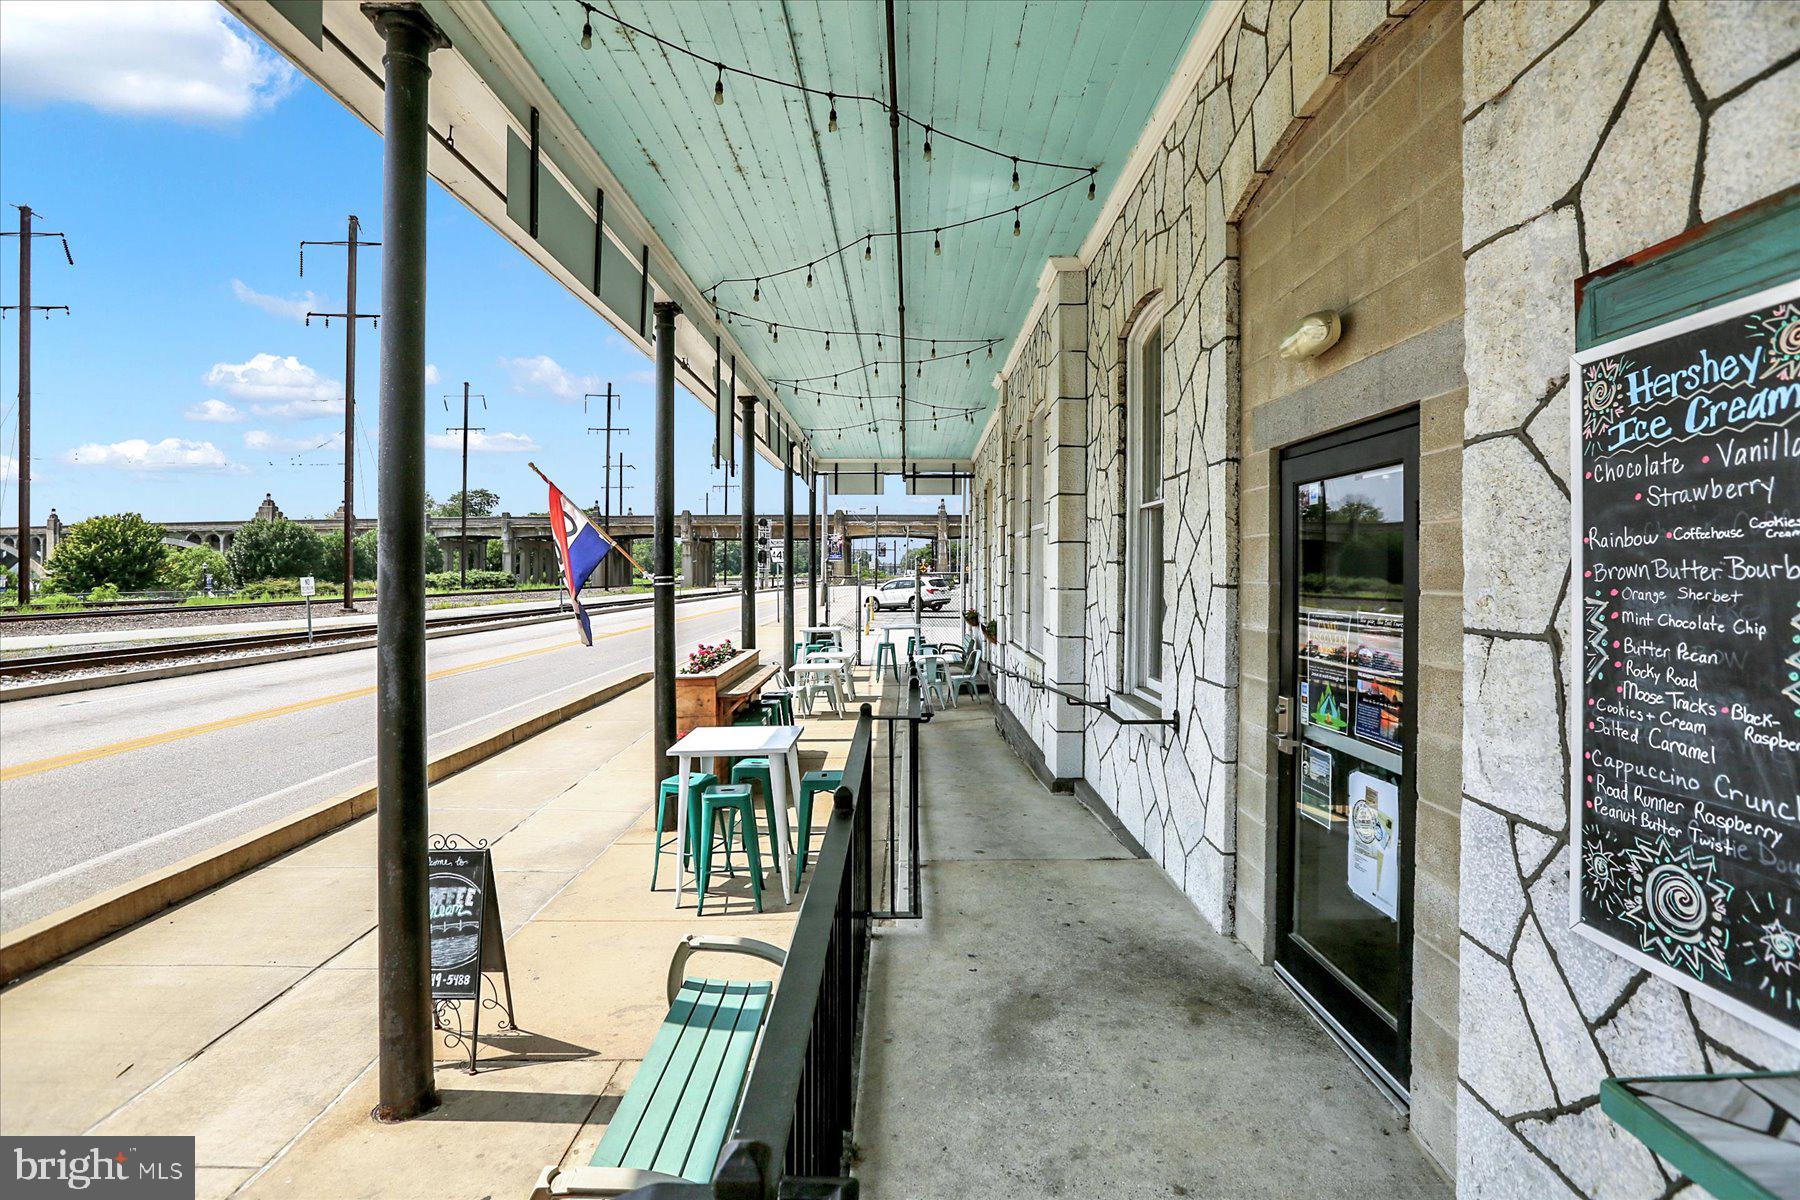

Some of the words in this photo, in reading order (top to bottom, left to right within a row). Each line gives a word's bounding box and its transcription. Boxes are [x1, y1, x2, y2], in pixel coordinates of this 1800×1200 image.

[1625, 346, 1762, 407] Hershey
[1608, 415, 1672, 451] Ice
[1685, 382, 1800, 434] Cream
[1594, 451, 1684, 483] Chocolate
[1646, 476, 1775, 507] Strawberry
[1588, 526, 1658, 550] Rainbow
[1593, 562, 1651, 582] Brown
[1651, 558, 1722, 581] Butter
[1723, 554, 1800, 581] Bourb
[1621, 587, 1667, 603] Orange
[1677, 587, 1744, 603] Sherbet
[1621, 608, 1653, 626] Mint
[1657, 613, 1725, 633] Chocolate
[1732, 619, 1767, 640] Chip
[1623, 637, 1670, 659] Butter
[1676, 642, 1718, 665] Pecan
[1626, 659, 1661, 684] Rocky
[1666, 667, 1699, 691] Road
[1622, 681, 1664, 704] Moose
[1665, 691, 1717, 716] Tracks
[1596, 697, 1643, 722] Cookies
[1659, 711, 1706, 736] Cream
[1594, 716, 1639, 744] Salted
[1648, 727, 1716, 764] Caramel
[1744, 726, 1800, 752] Raspber
[1591, 749, 1700, 791] Cappuccino
[1593, 796, 1637, 825] Peanut
[1641, 812, 1682, 839] Butter
[1596, 773, 1628, 803] Road
[1633, 785, 1685, 815] Runner
[1694, 800, 1783, 848] Raspberry
[429, 886, 477, 907] OFFEE
[431, 972, 470, 988] 49-5488
